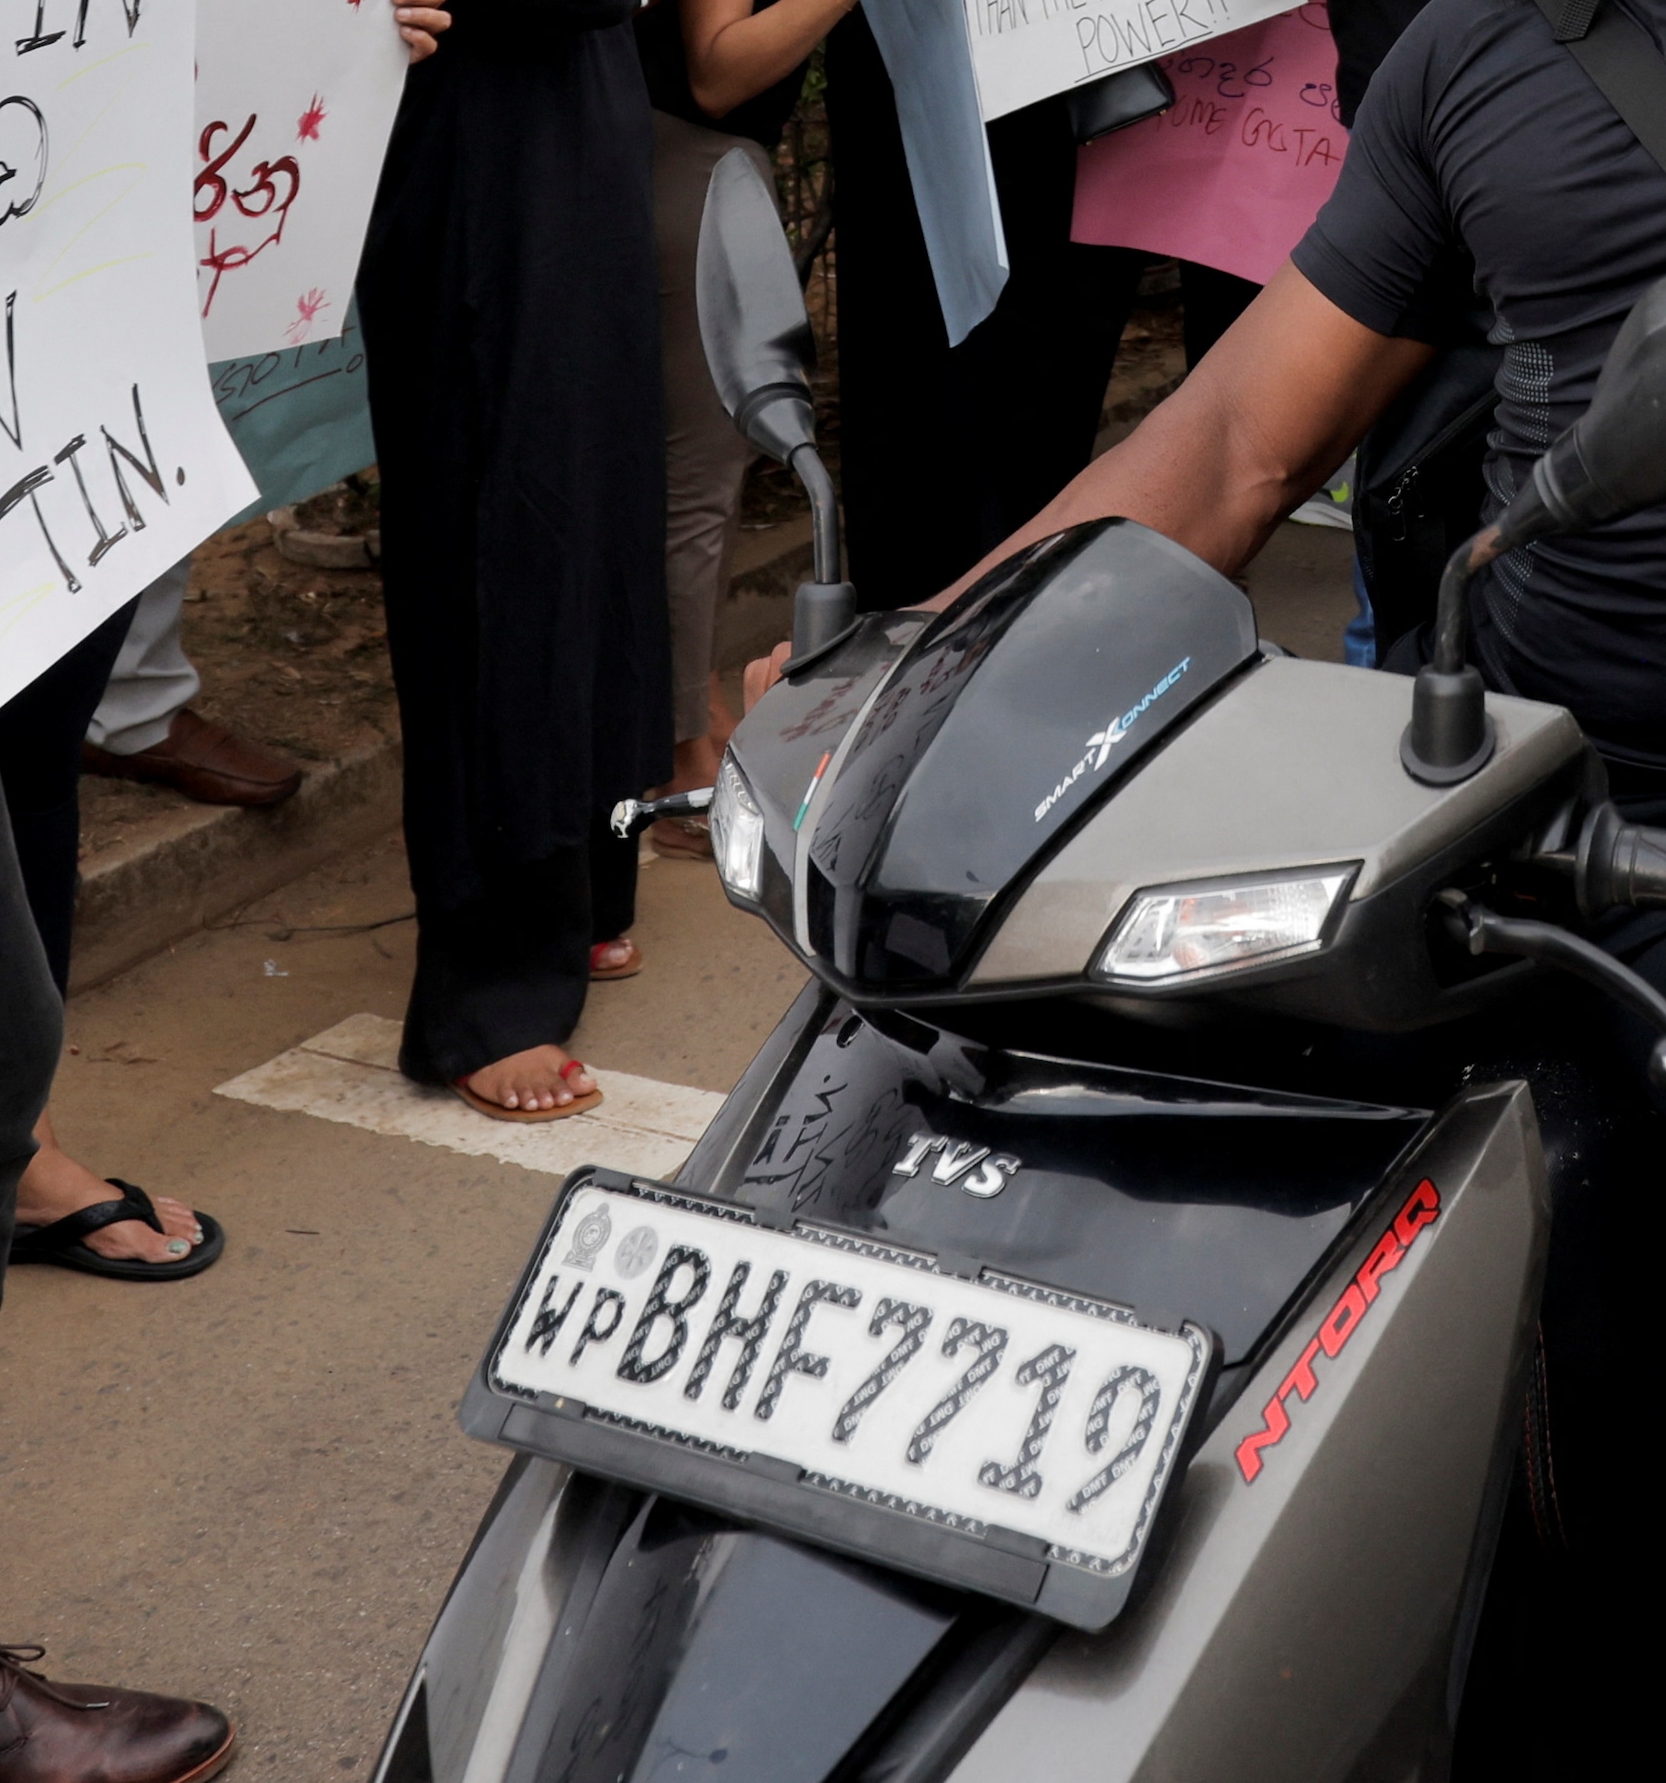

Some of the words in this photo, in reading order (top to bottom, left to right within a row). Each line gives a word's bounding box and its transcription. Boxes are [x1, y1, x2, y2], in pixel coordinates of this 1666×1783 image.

[892, 1131, 1023, 1200] TVS
[523, 1274, 627, 1369] WP
[1235, 1178, 1443, 1484] NTORQ
